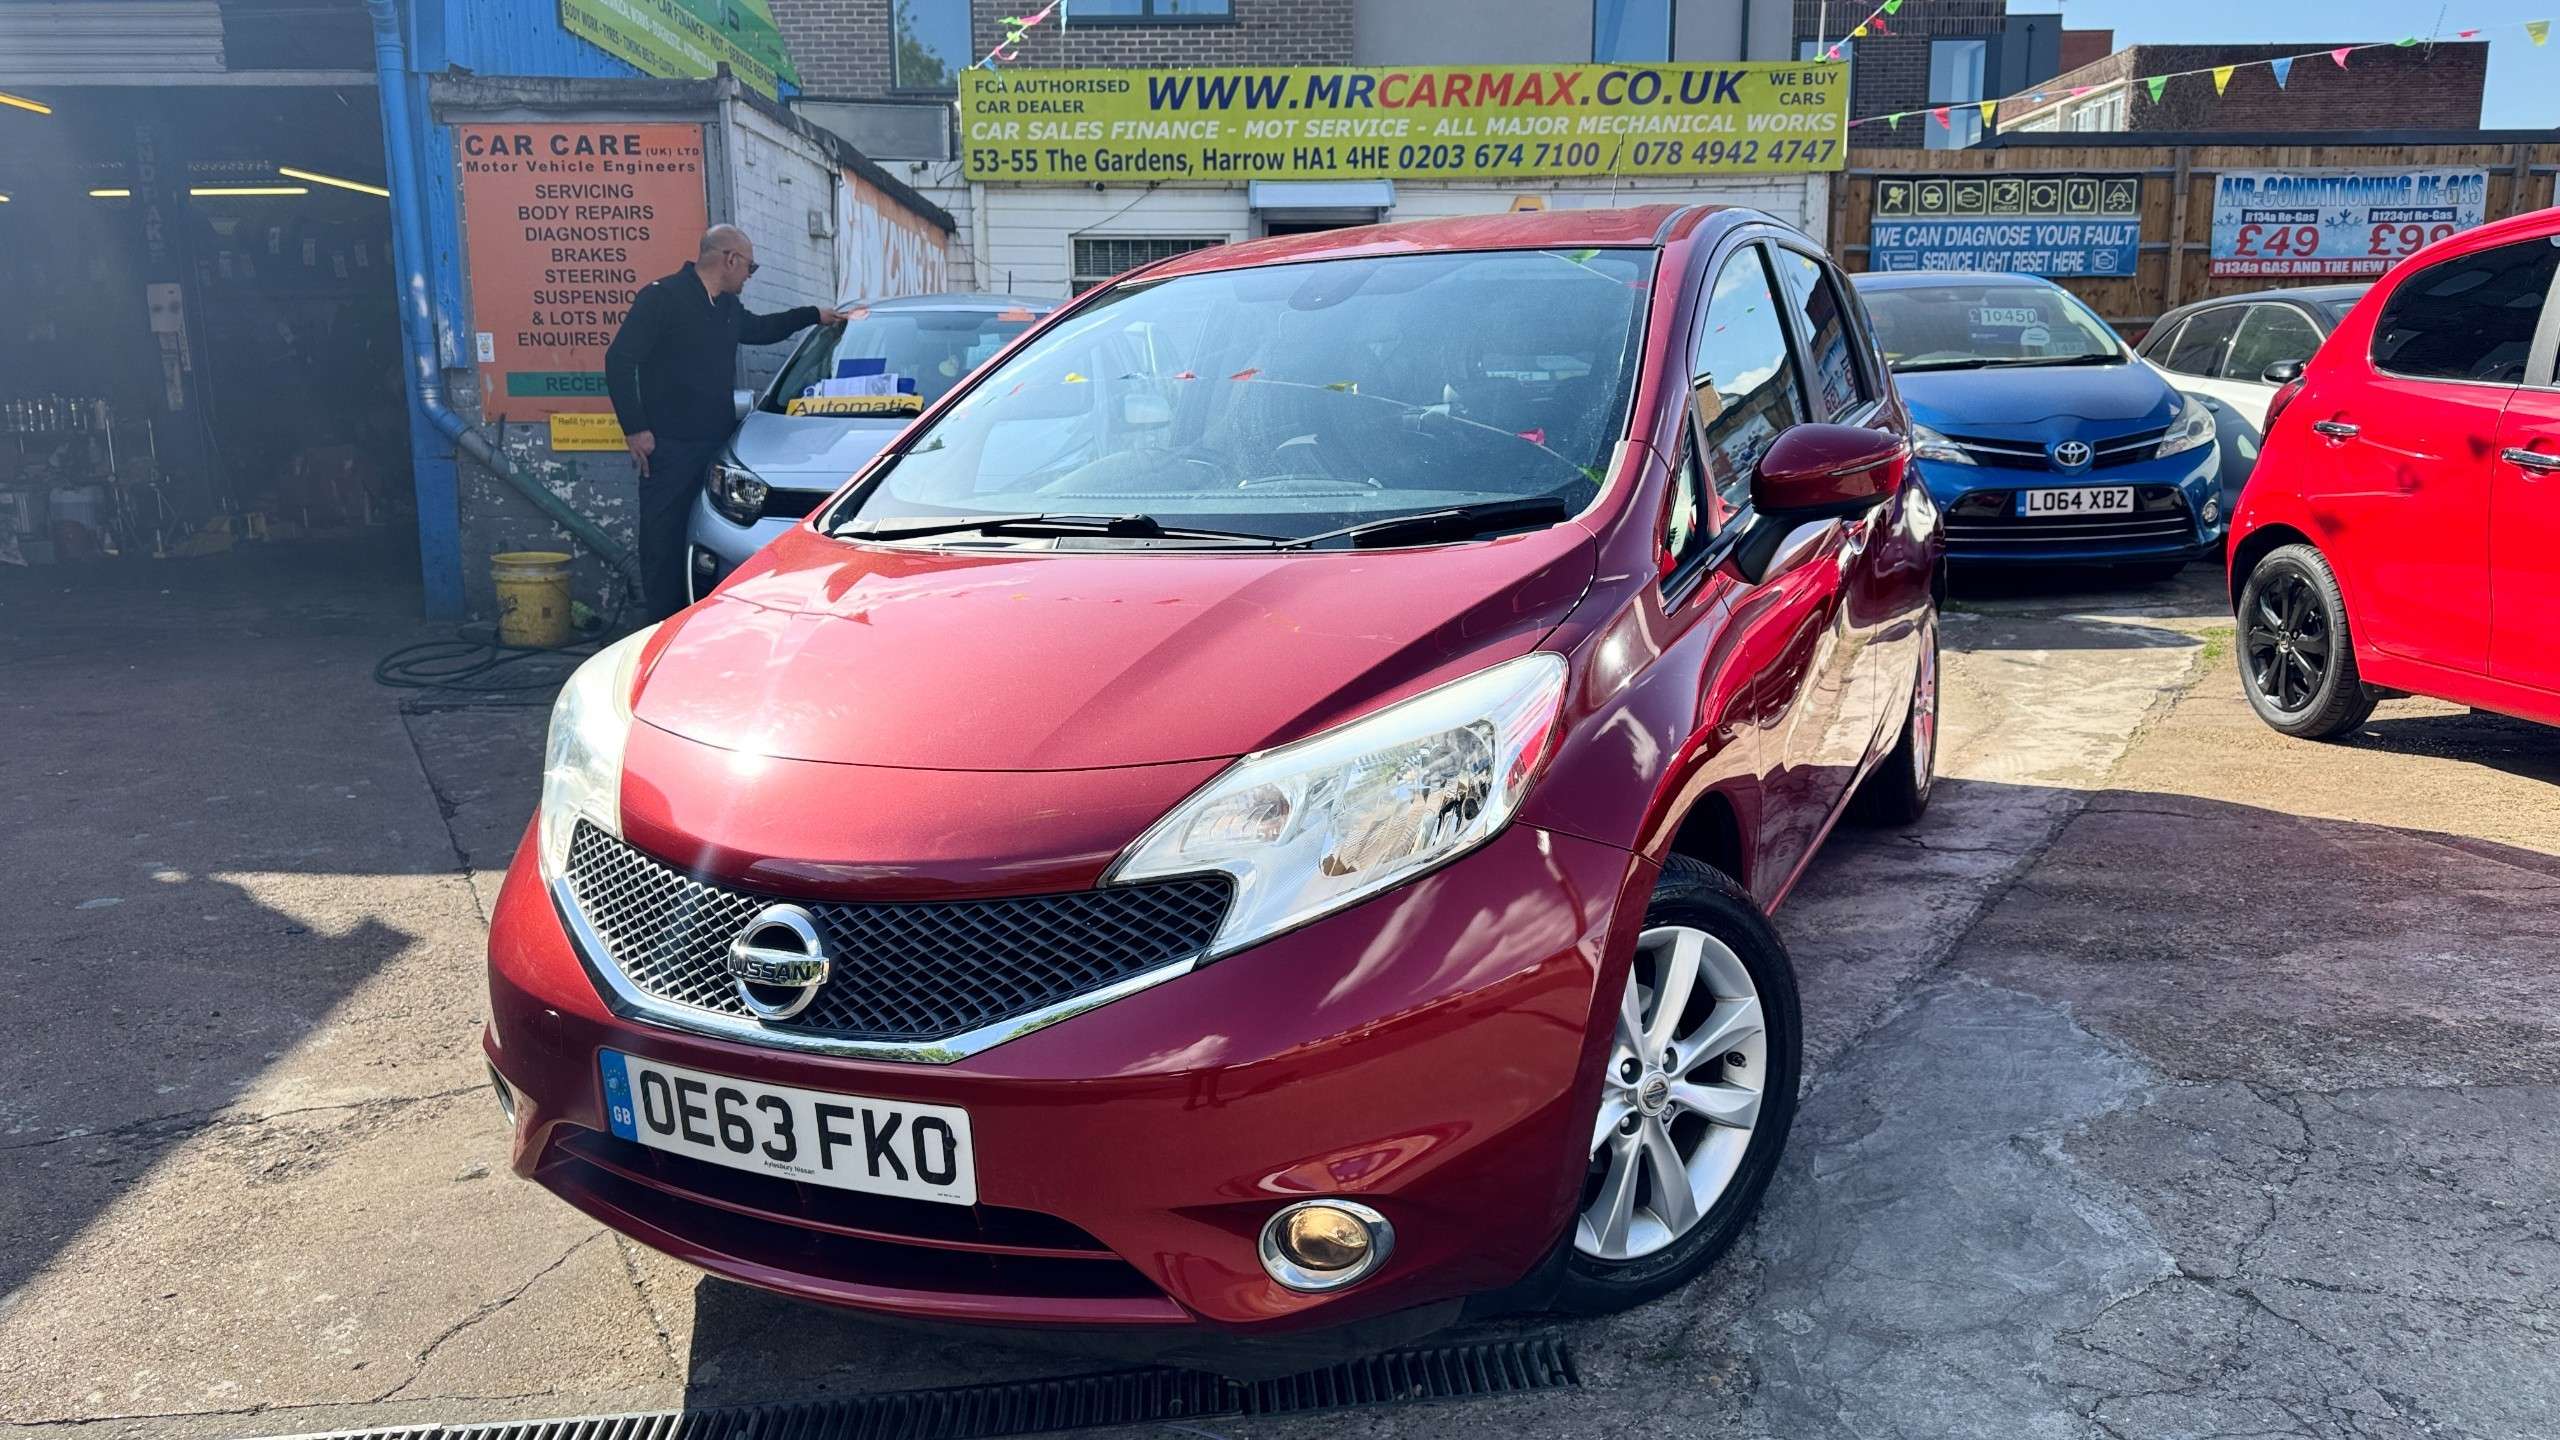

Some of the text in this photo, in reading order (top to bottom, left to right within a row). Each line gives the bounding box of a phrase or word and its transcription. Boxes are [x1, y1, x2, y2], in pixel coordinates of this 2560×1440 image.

[974, 79, 1130, 94] FCA AUTHORISED
[1769, 72, 1838, 86] WE BUY
[1147, 69, 1749, 110] WWW.MRCARMAX.CO.UK
[975, 100, 1085, 114] CAR DEALER
[1779, 93, 1825, 106] CARS
[971, 121, 1020, 141] CAR
[1027, 120, 1103, 141] SALES
[1110, 120, 1219, 140] FINANCE
[1244, 119, 1297, 139] MOT
[1304, 119, 1408, 138] SERVICE
[1433, 118, 1477, 137] ALL
[1485, 117, 1569, 137] MAJOR
[1576, 114, 1737, 136] MECHANICAL
[1746, 113, 1837, 133] WORKS
[465, 134, 534, 156] CAR
[550, 134, 642, 156] CARE
[677, 147, 700, 156] LTD
[972, 149, 1038, 173] 53-55
[1045, 148, 1087, 172] The
[1095, 148, 1194, 176] Gardens,
[1202, 147, 1287, 171] Harrow
[1292, 147, 1338, 170] HA1
[1346, 146, 1390, 170] 4HE
[1399, 144, 1464, 169] 0203
[1474, 143, 1524, 168] 674
[1535, 143, 1599, 168] 7100
[1632, 141, 1682, 166] 078
[1691, 141, 1759, 165] 4942
[1767, 140, 1837, 164] 4747
[466, 160, 696, 175] Motor Vehicle Engineers
[535, 184, 634, 199] SERVICING
[2219, 174, 2484, 207] AIR-CONDITIONING RE-GAS
[518, 205, 654, 220] BODY REPAIRS
[2245, 211, 2316, 223] R134a Re-Gas
[2414, 210, 2454, 221] Re-Gas
[525, 226, 650, 242] DIAGNOSTICS
[1875, 225, 2135, 247] WE CAN DIAGNOSE YOUR FAULT
[2234, 224, 2320, 256] £49
[551, 248, 627, 262] BRAKES
[1921, 251, 2085, 272] SERVICE LIGHT RESET HERE
[2214, 263, 2257, 275] R134a
[2261, 262, 2290, 274] GAS
[2292, 262, 2321, 274] AND
[2324, 261, 2350, 274] THE
[2352, 261, 2386, 273] NEW
[545, 269, 636, 284] STEERING
[533, 290, 637, 305] SUSPENSIO
[532, 311, 544, 325] &
[550, 311, 597, 325] LOTS
[518, 331, 610, 347] ENQUIRES
[791, 398, 918, 416] Automatic
[2030, 490, 2129, 511] LO64 XBZ
[613, 1105, 632, 1126] GB
[639, 1069, 957, 1186] OE63 FKO
